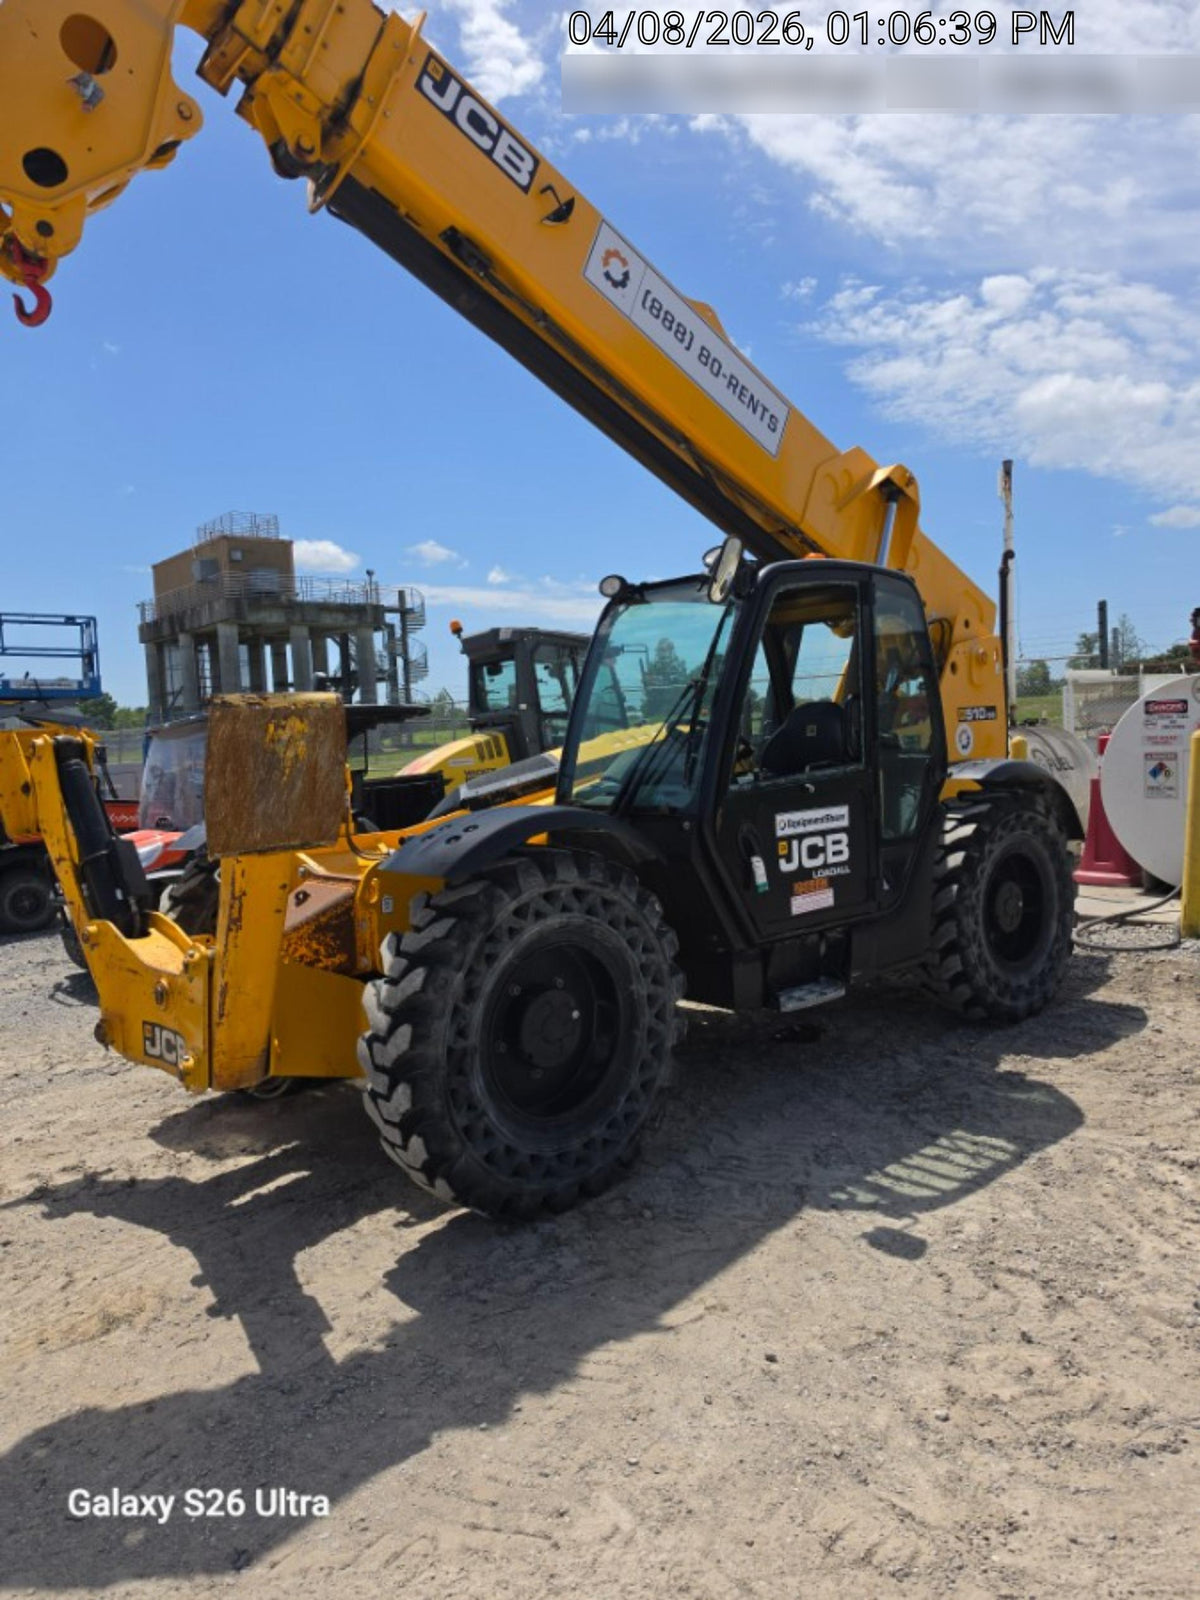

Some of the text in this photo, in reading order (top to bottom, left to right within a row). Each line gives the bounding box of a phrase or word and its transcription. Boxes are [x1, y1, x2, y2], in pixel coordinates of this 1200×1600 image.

[420, 72, 536, 187] JCB
[641, 289, 780, 433] (888) 80-RENTS
[778, 832, 850, 872] JCB
